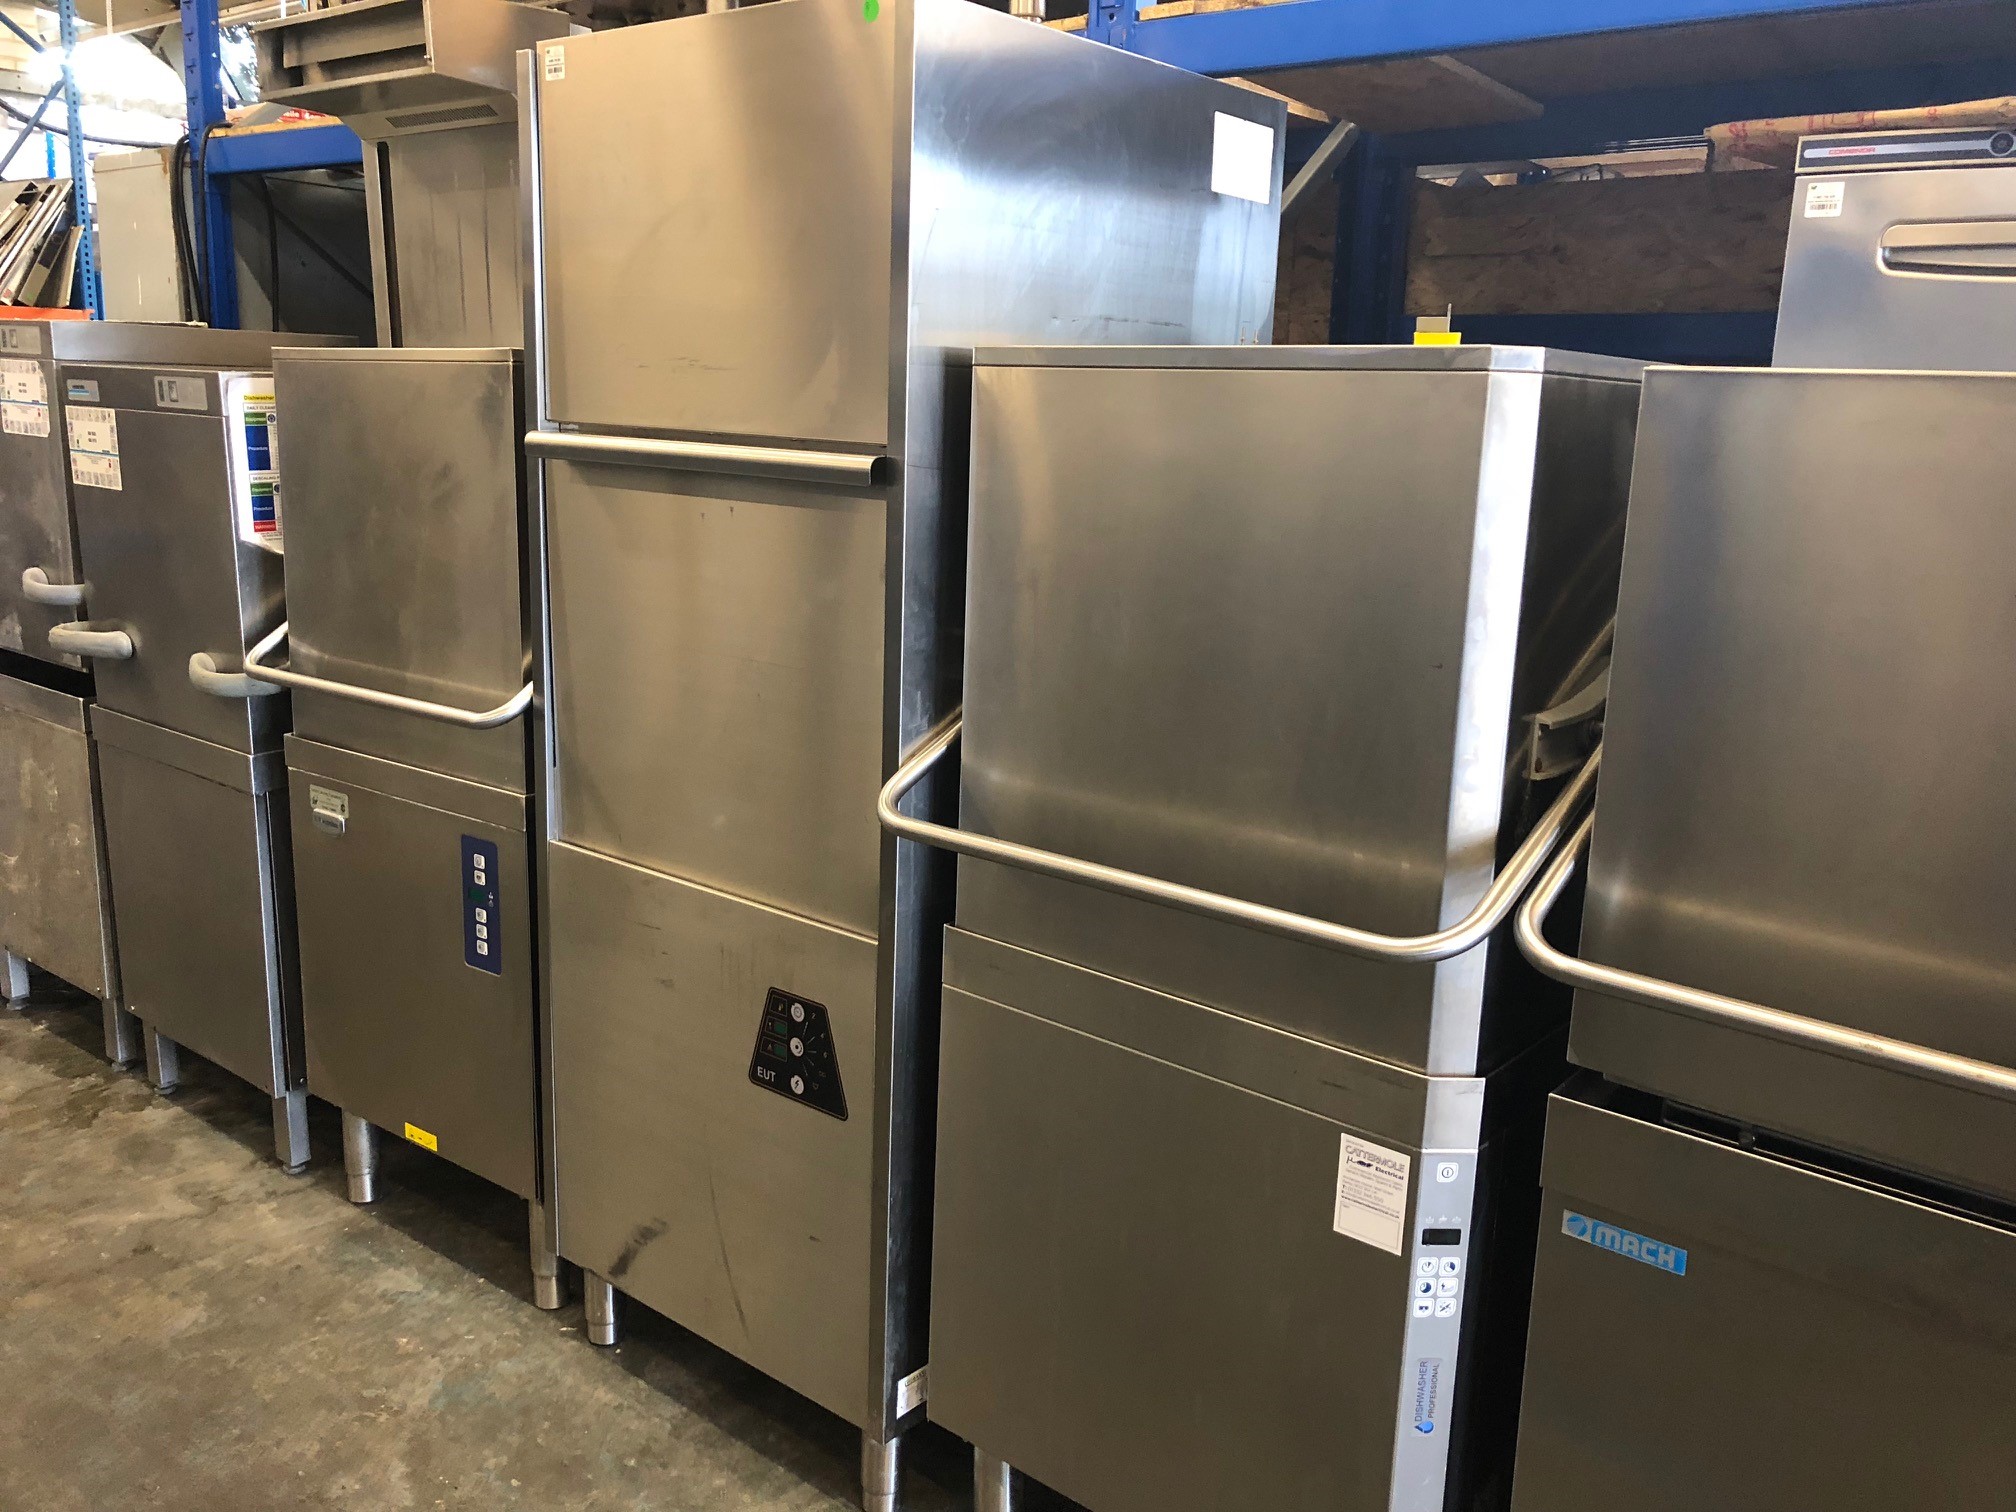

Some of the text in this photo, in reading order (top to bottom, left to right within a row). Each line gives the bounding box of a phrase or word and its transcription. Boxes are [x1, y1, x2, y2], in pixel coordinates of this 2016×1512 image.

[757, 1065, 776, 1082] EUT
[1345, 1145, 1406, 1174] CATTERMOLE
[1375, 1165, 1404, 1181] Electrical
[1595, 1226, 1676, 1269] MACH
[1414, 1360, 1429, 1422] DISHWASHER
[1427, 1362, 1441, 1419] PROFESSIONAL
